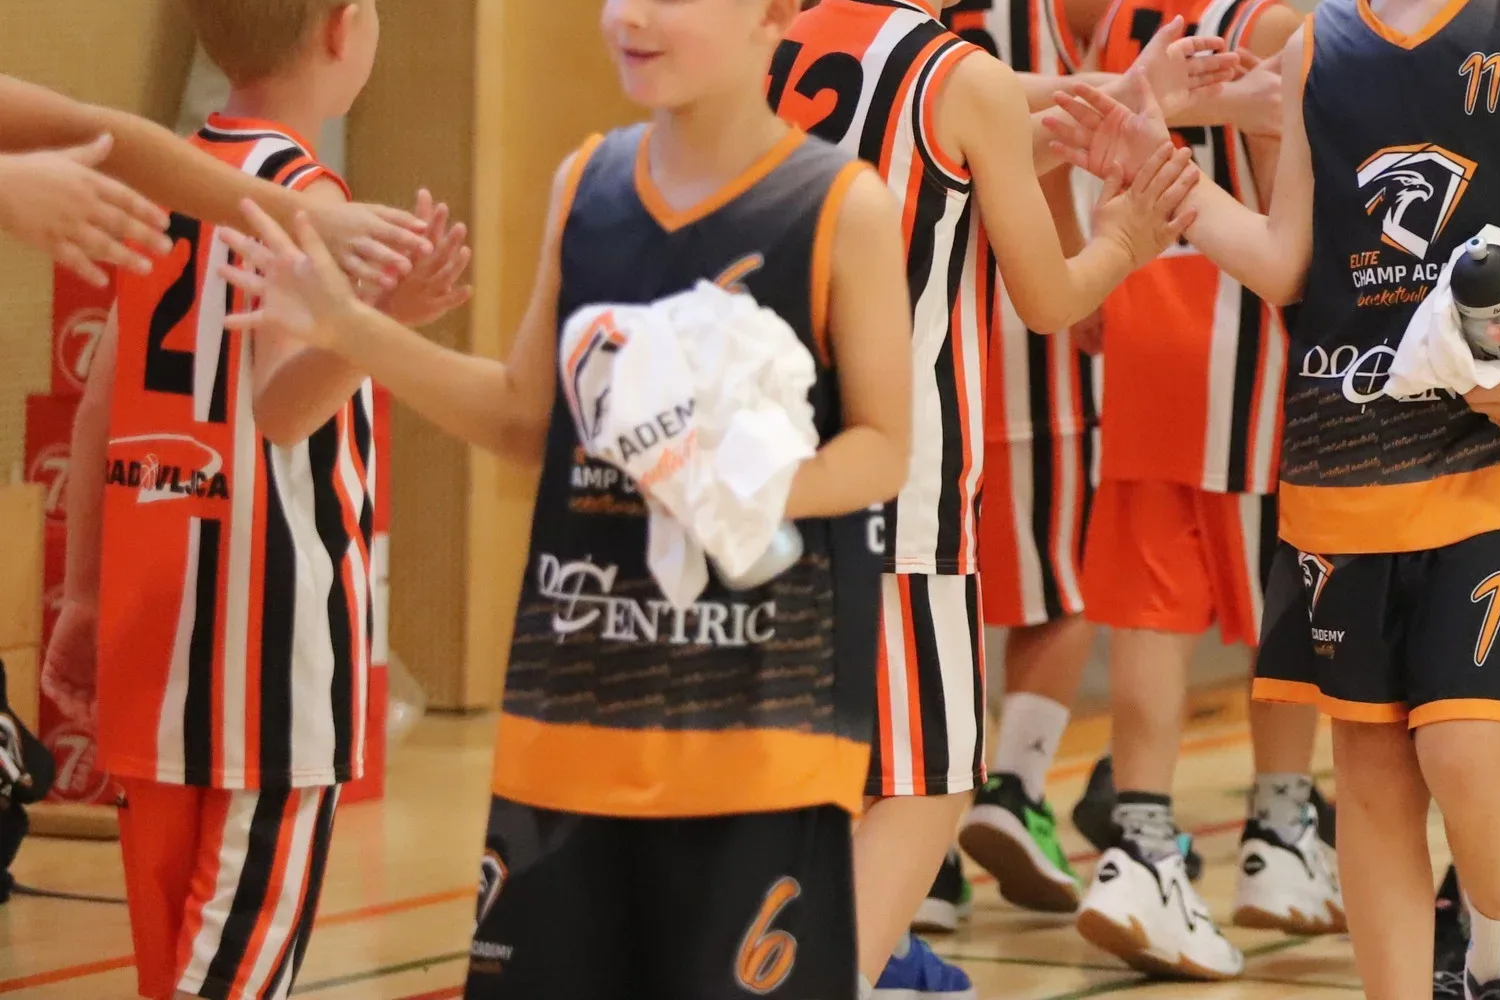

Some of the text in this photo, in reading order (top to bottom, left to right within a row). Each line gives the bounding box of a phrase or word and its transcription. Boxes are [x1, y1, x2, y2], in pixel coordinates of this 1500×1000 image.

[767, 39, 864, 145] 12
[144, 211, 198, 397] 2
[1352, 264, 1407, 289] CHAMP
[1356, 286, 1429, 308] basketball
[732, 875, 801, 995] 6
